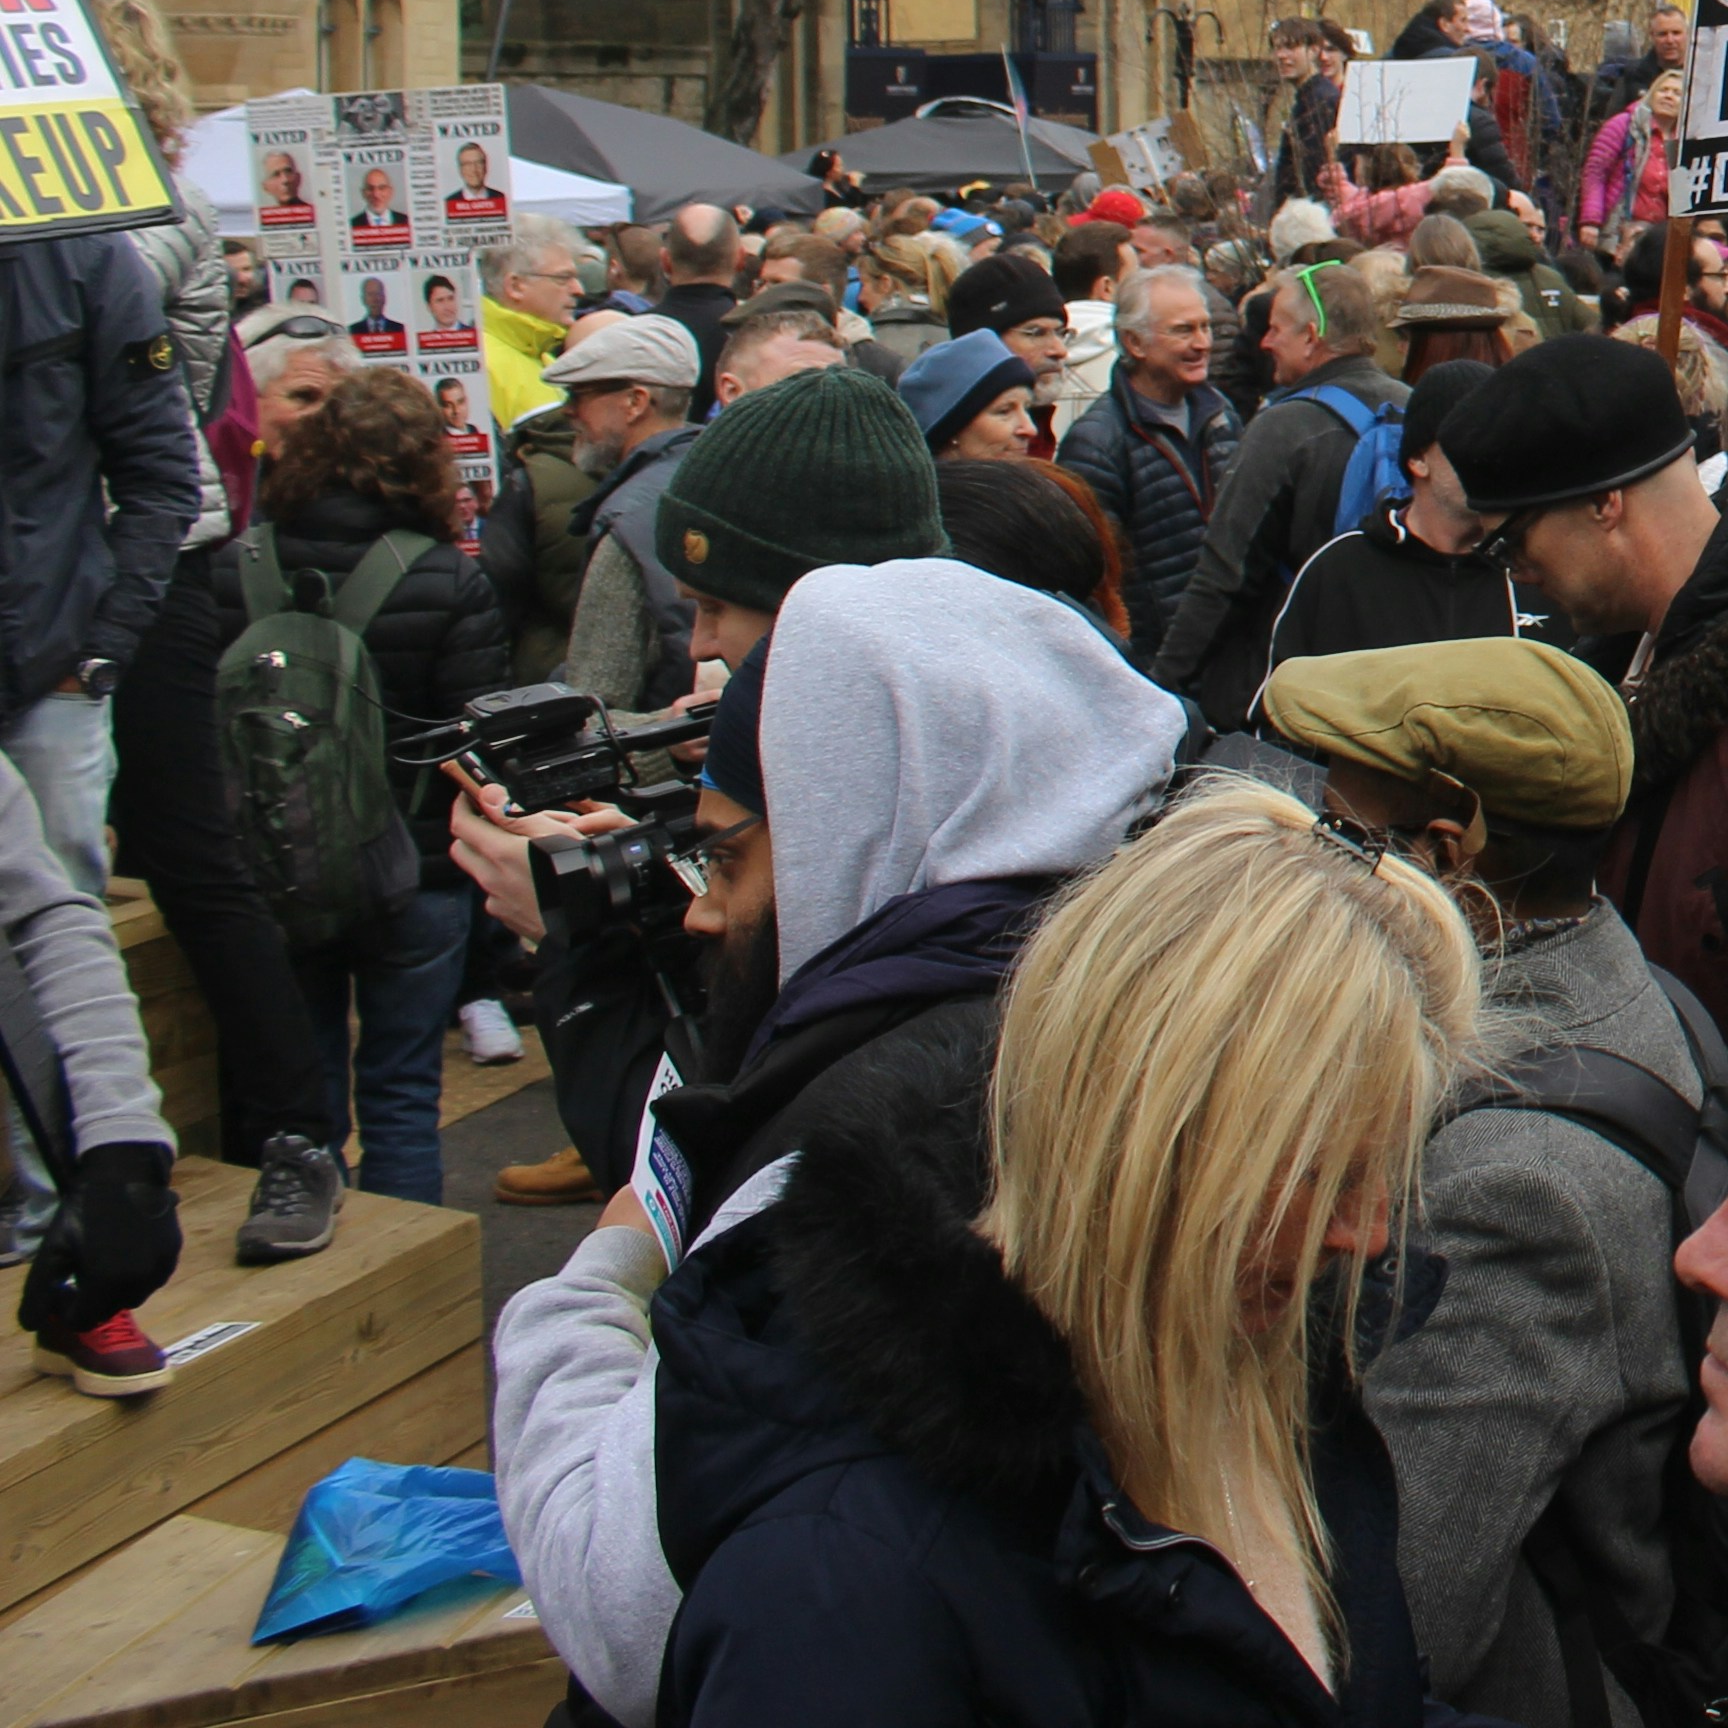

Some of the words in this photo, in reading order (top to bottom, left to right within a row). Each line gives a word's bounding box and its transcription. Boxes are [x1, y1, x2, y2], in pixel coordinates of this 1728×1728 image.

[251, 129, 307, 145] WANTED
[438, 123, 500, 138] WANTED
[343, 149, 405, 164] WANTED
[274, 260, 321, 275] WANTE
[340, 258, 400, 273] WANTED
[408, 252, 471, 269] WANTED
[418, 360, 481, 374] WANTED
